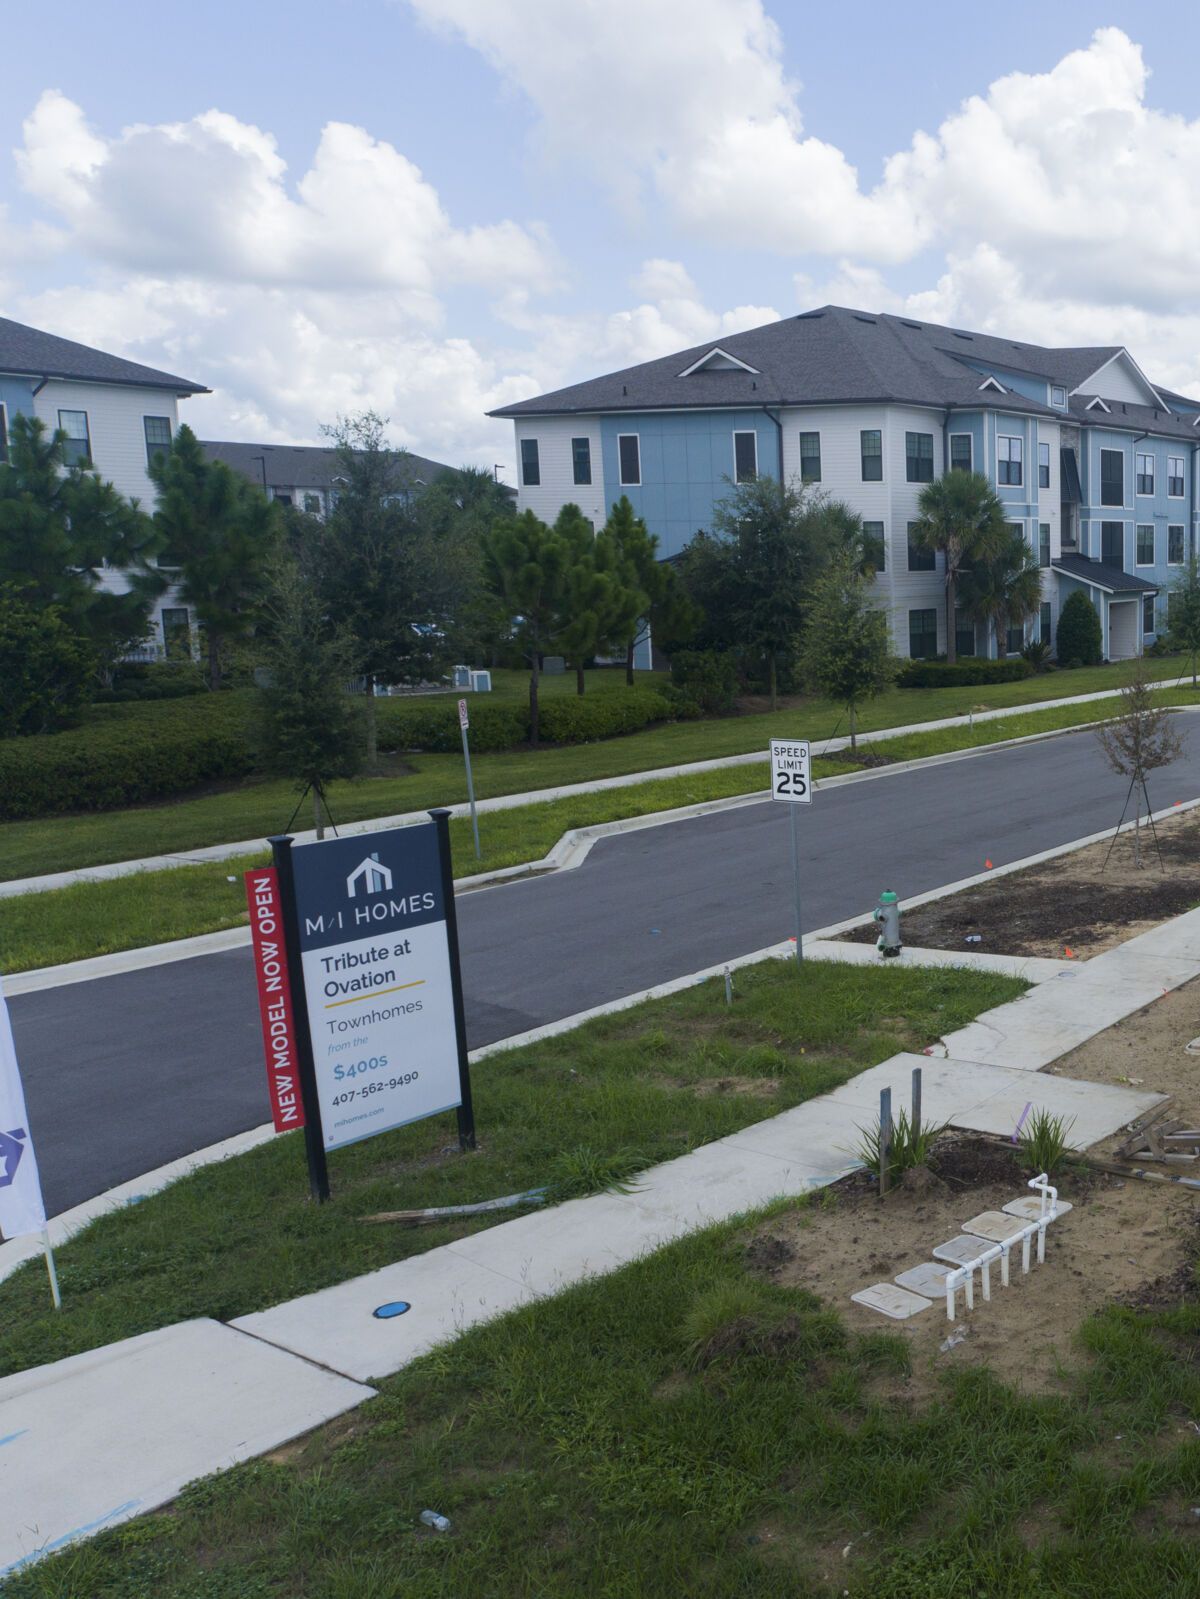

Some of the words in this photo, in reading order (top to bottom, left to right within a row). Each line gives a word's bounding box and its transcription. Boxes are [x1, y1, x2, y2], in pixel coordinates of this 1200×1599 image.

[773, 746, 807, 758] SPEED
[777, 760, 804, 770] LIMIT
[776, 771, 807, 796] 25
[253, 877, 276, 935] OPEN
[355, 892, 436, 925] HOMES
[260, 941, 282, 993] NOW
[320, 947, 390, 974] Tribute
[394, 939, 412, 957] at
[324, 969, 396, 998] Ovation
[268, 996, 291, 1069] MODEL
[326, 1000, 424, 1035] Townhomes
[328, 1041, 351, 1057] from
[353, 1036, 369, 1048] the
[275, 1075, 298, 1123] NEW
[332, 1071, 419, 1107] 407-562-9490
[334, 1107, 385, 1128] mihomes.com
